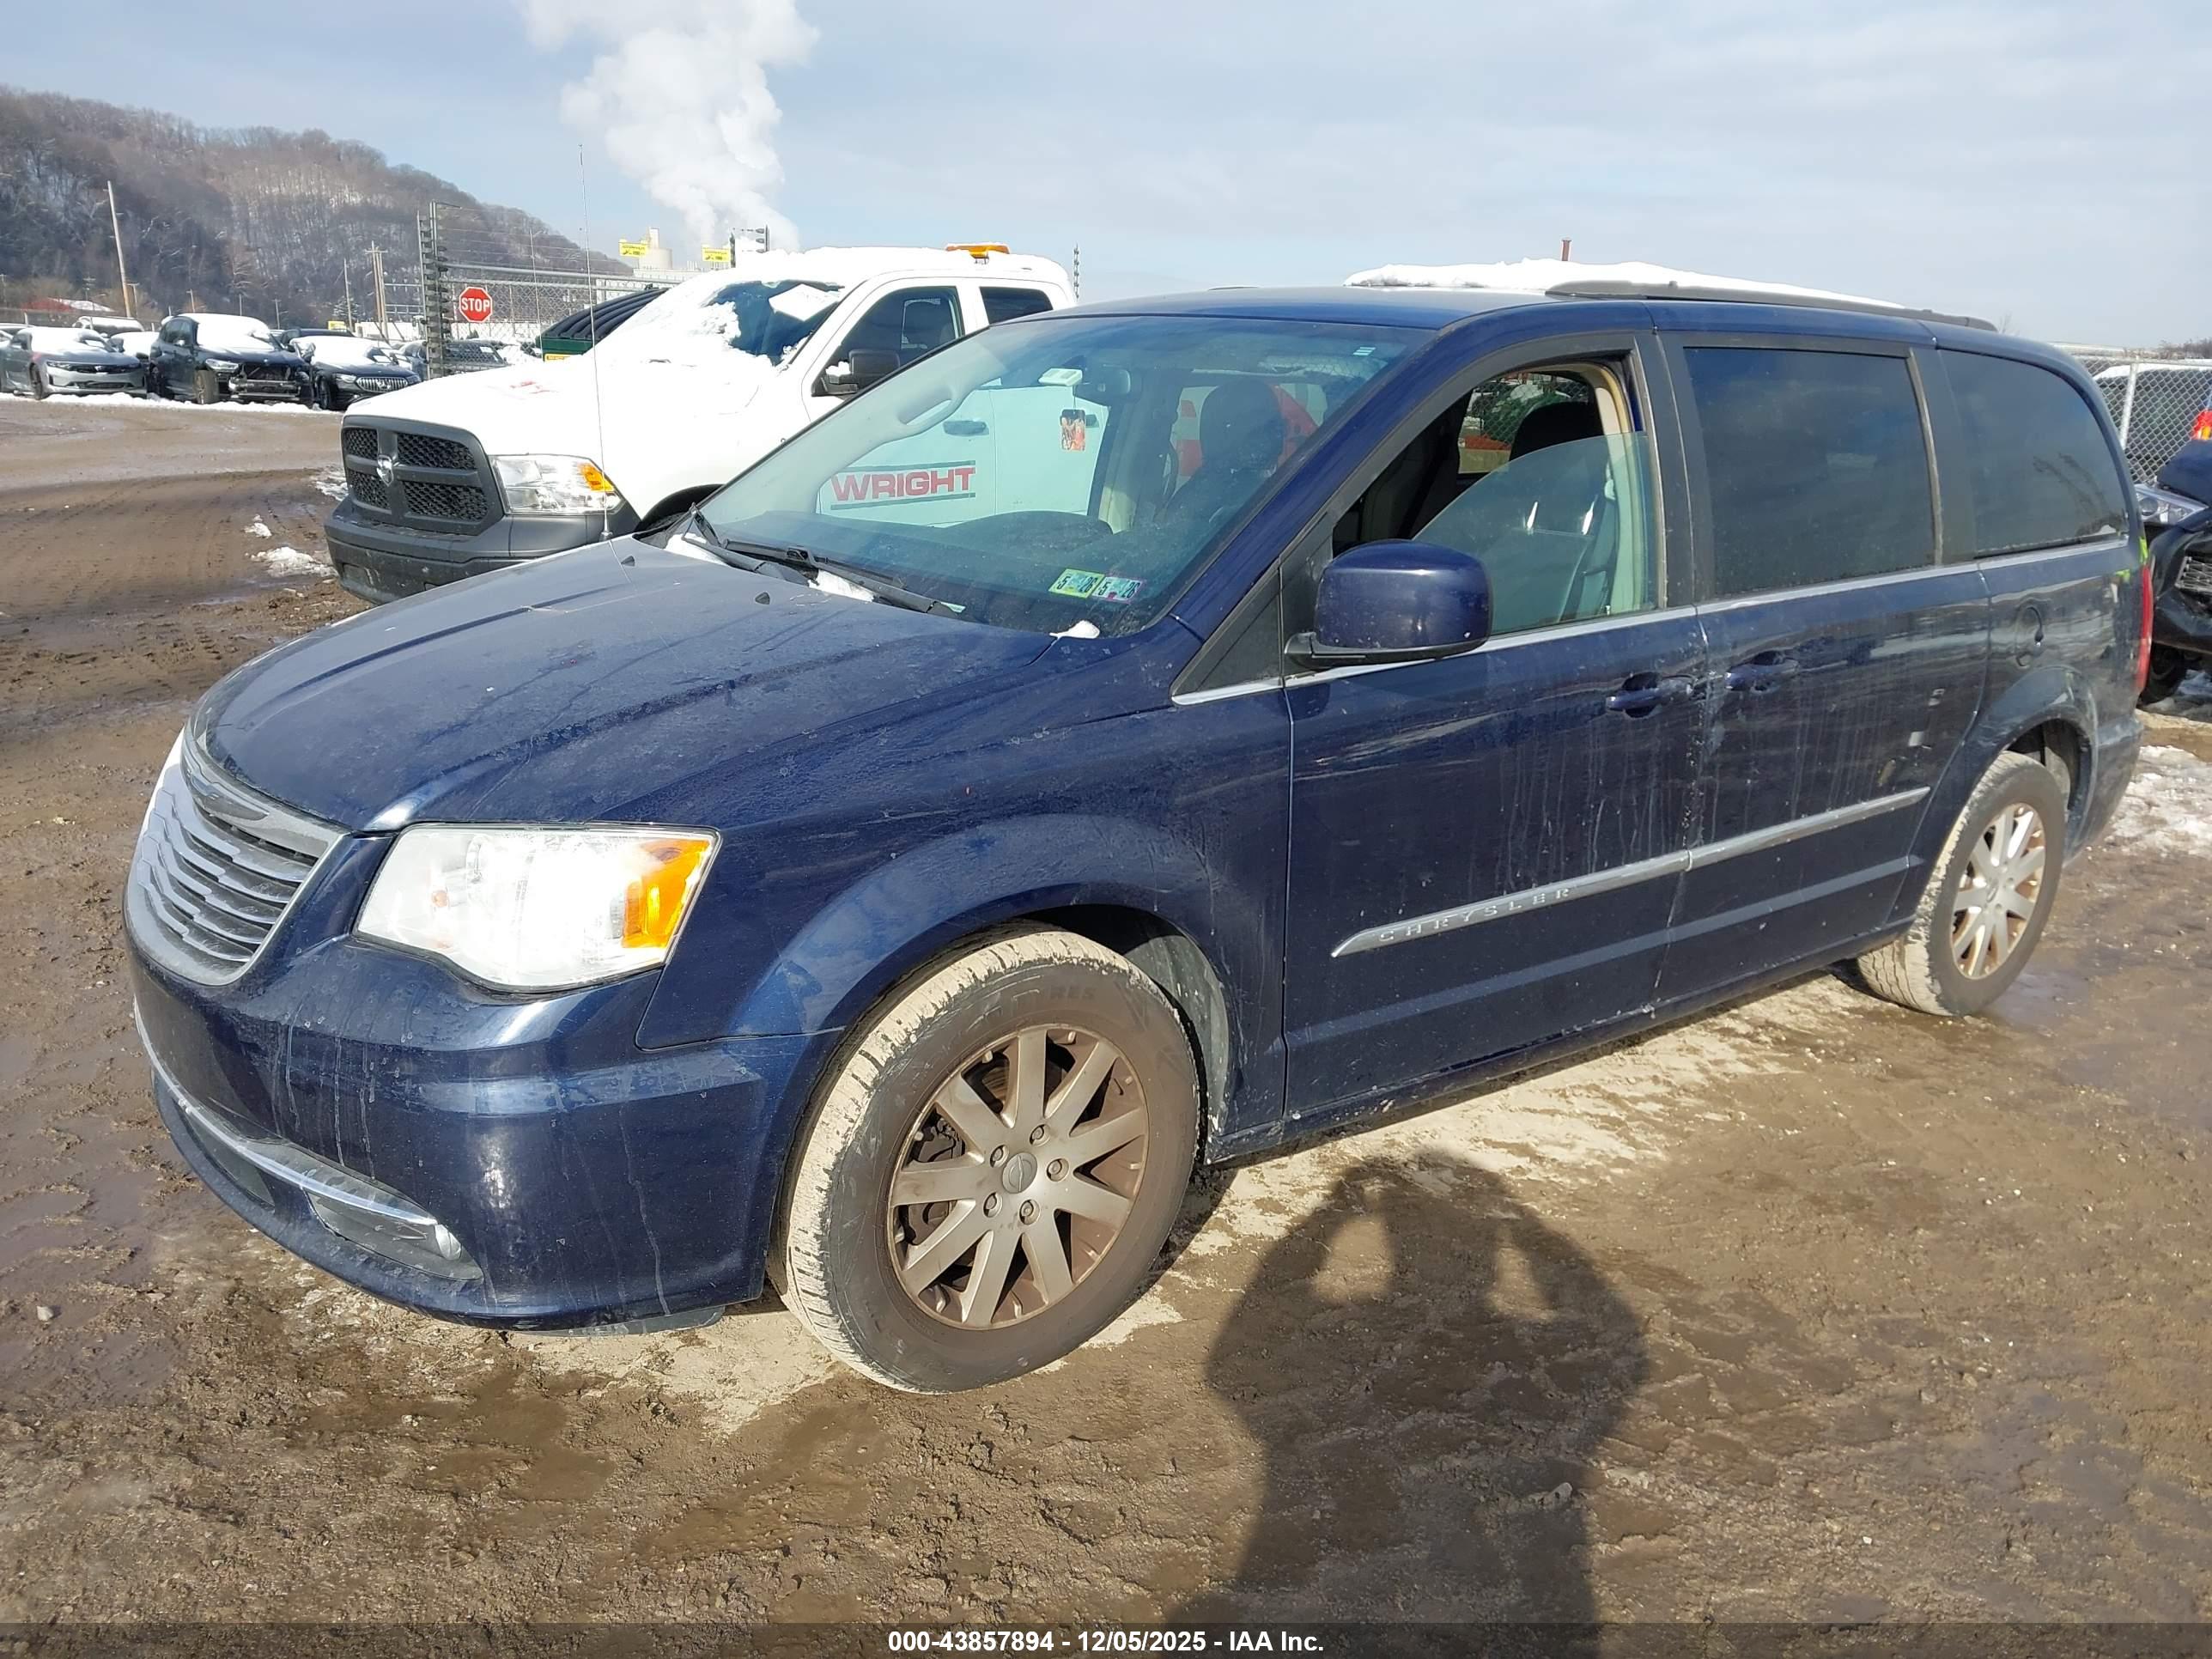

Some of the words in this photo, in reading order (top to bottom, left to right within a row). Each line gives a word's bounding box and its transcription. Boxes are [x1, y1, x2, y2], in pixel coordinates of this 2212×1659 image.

[461, 297, 490, 313] STOP
[830, 466, 976, 501] WRIGHT
[1380, 888, 1570, 942] CHRYSLER
